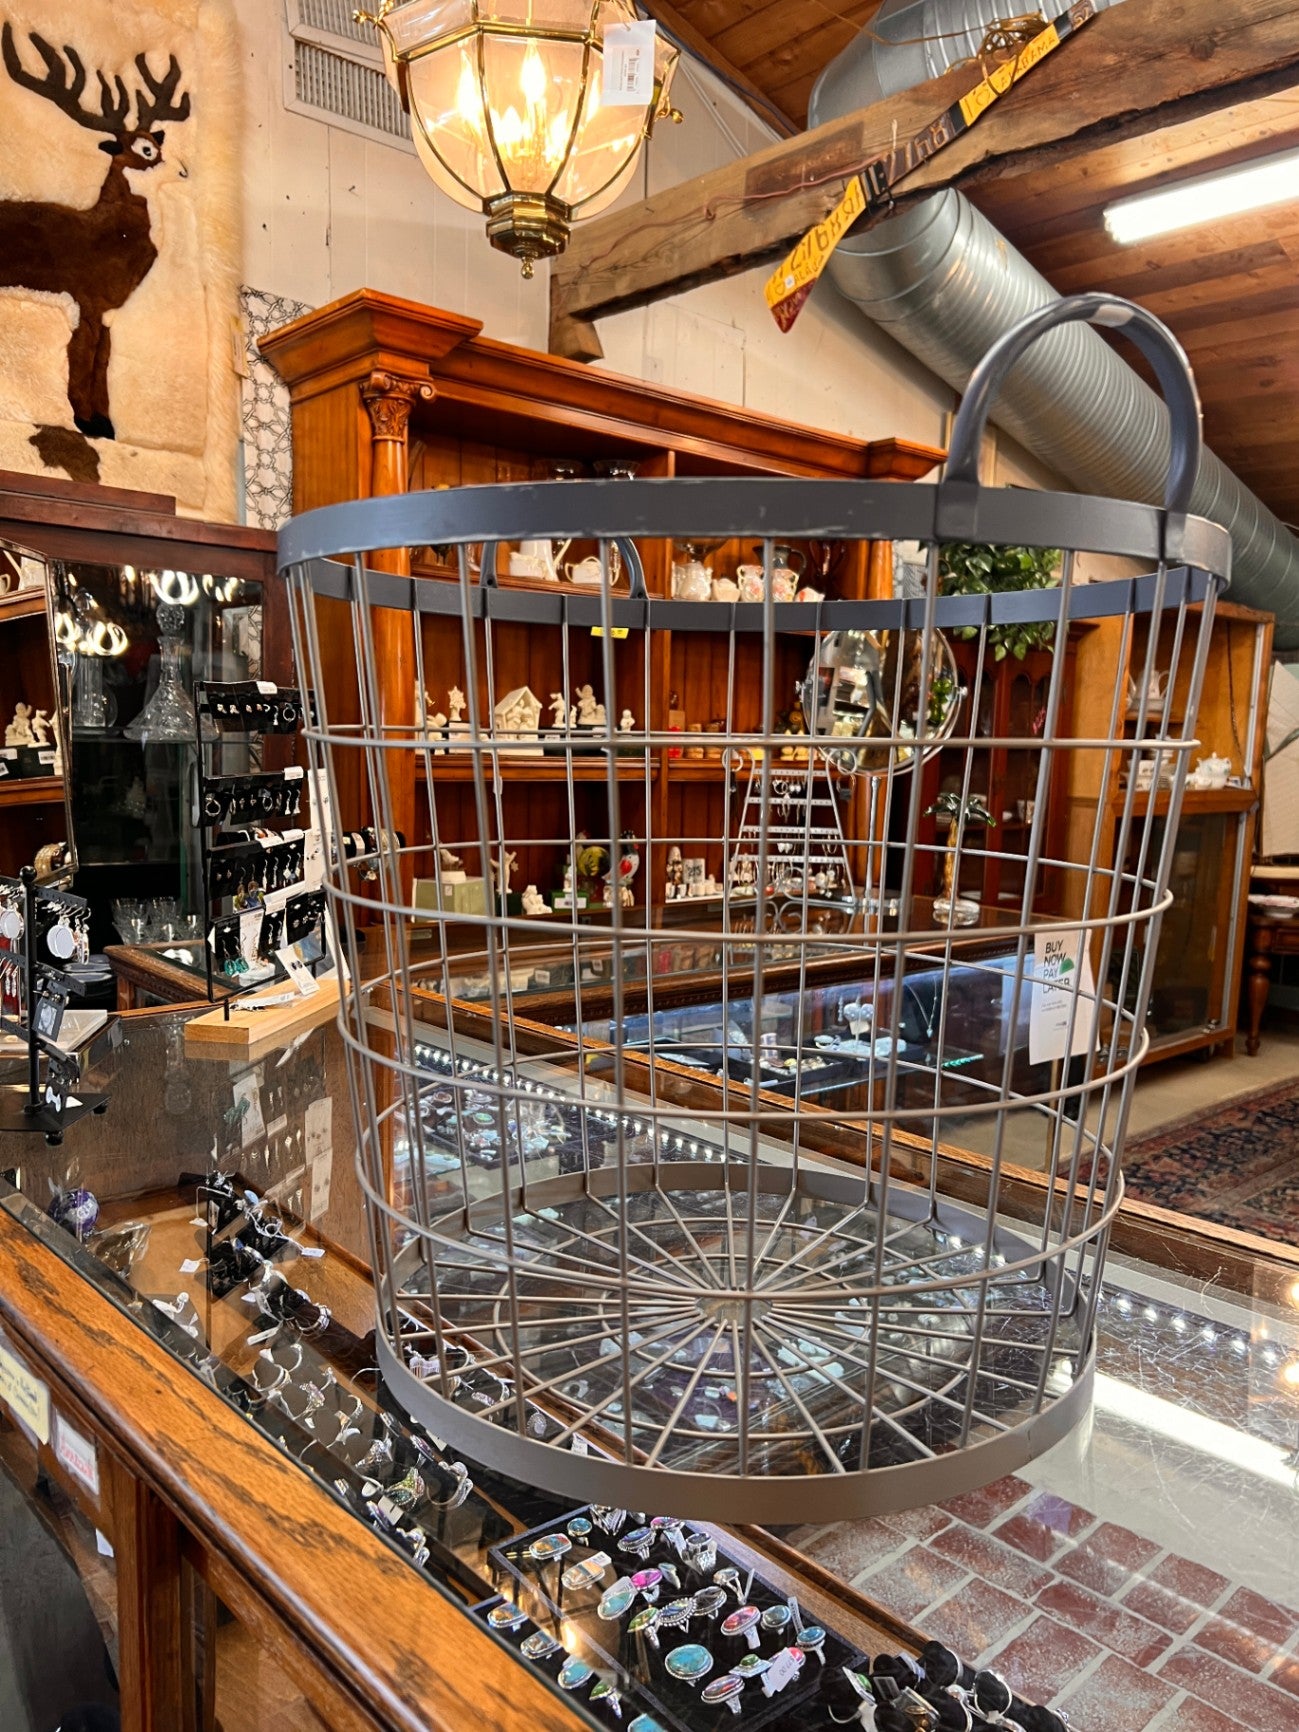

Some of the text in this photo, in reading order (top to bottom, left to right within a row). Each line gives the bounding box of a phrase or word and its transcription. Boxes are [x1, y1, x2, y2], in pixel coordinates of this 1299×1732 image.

[1046, 940, 1063, 954] BUY
[1044, 953, 1066, 967] NOW
[1044, 968, 1058, 979] PAY
